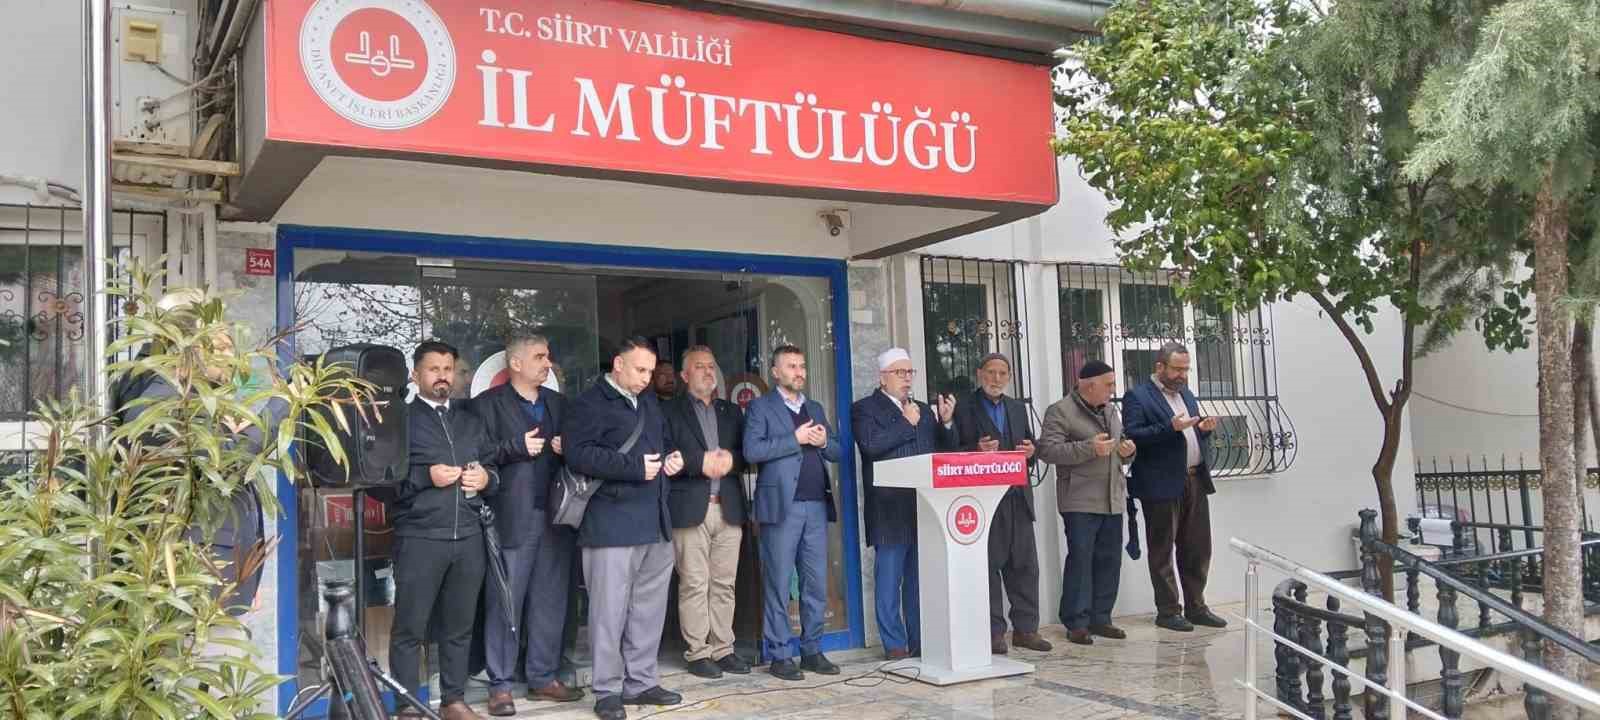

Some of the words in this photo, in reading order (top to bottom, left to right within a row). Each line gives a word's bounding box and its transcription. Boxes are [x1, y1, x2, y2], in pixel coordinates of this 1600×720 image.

[480, 8, 531, 38] T.C.
[536, 13, 613, 49] SİİRT
[617, 28, 733, 66] VALİLİĞİ
[476, 49, 556, 132] İL
[570, 73, 979, 173] MÜFTÜLÜĞÜ
[249, 256, 272, 269] 54A
[937, 463, 964, 476] SİİRT
